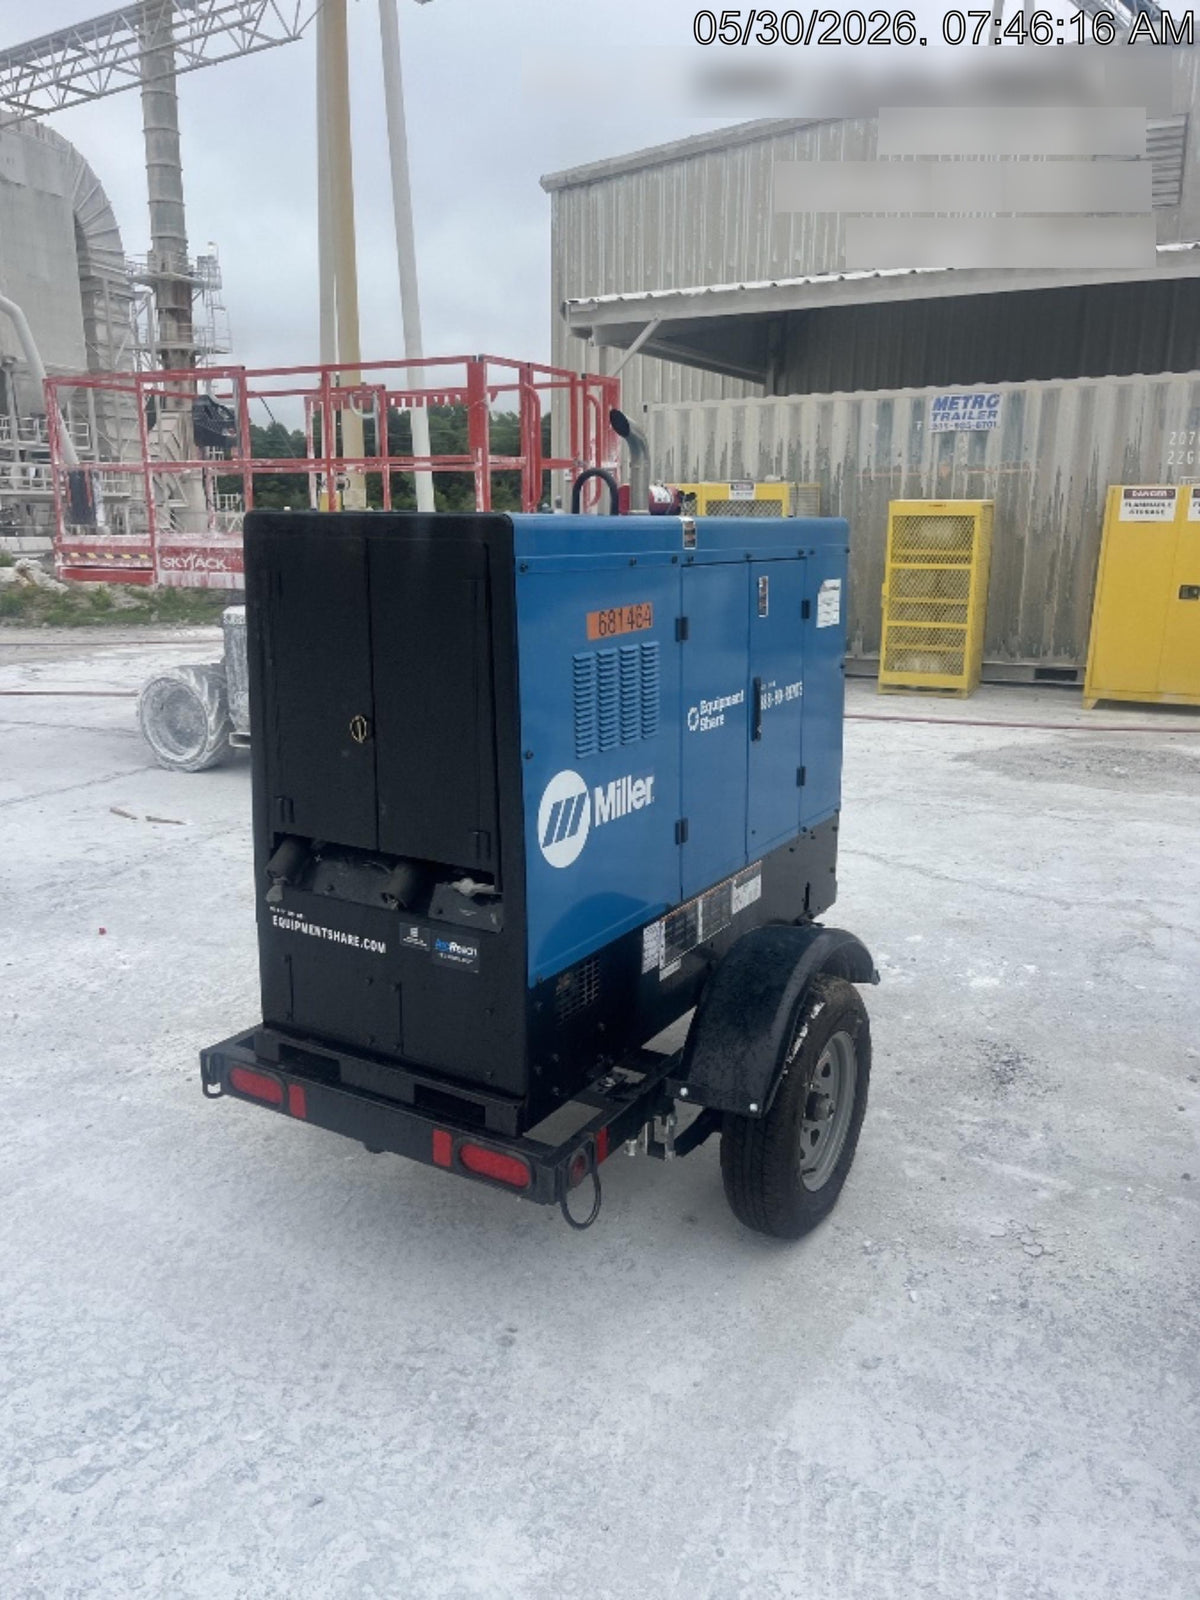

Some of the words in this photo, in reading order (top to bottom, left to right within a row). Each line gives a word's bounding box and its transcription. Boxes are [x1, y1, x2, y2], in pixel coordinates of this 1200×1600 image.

[932, 394, 1000, 411] METRO
[931, 411, 998, 421] TRAILER
[162, 552, 232, 571] SKYJACK
[700, 714, 725, 731] Share
[594, 775, 654, 827] Miller
[272, 915, 387, 954] EQUIPMENTSHARE.COM
